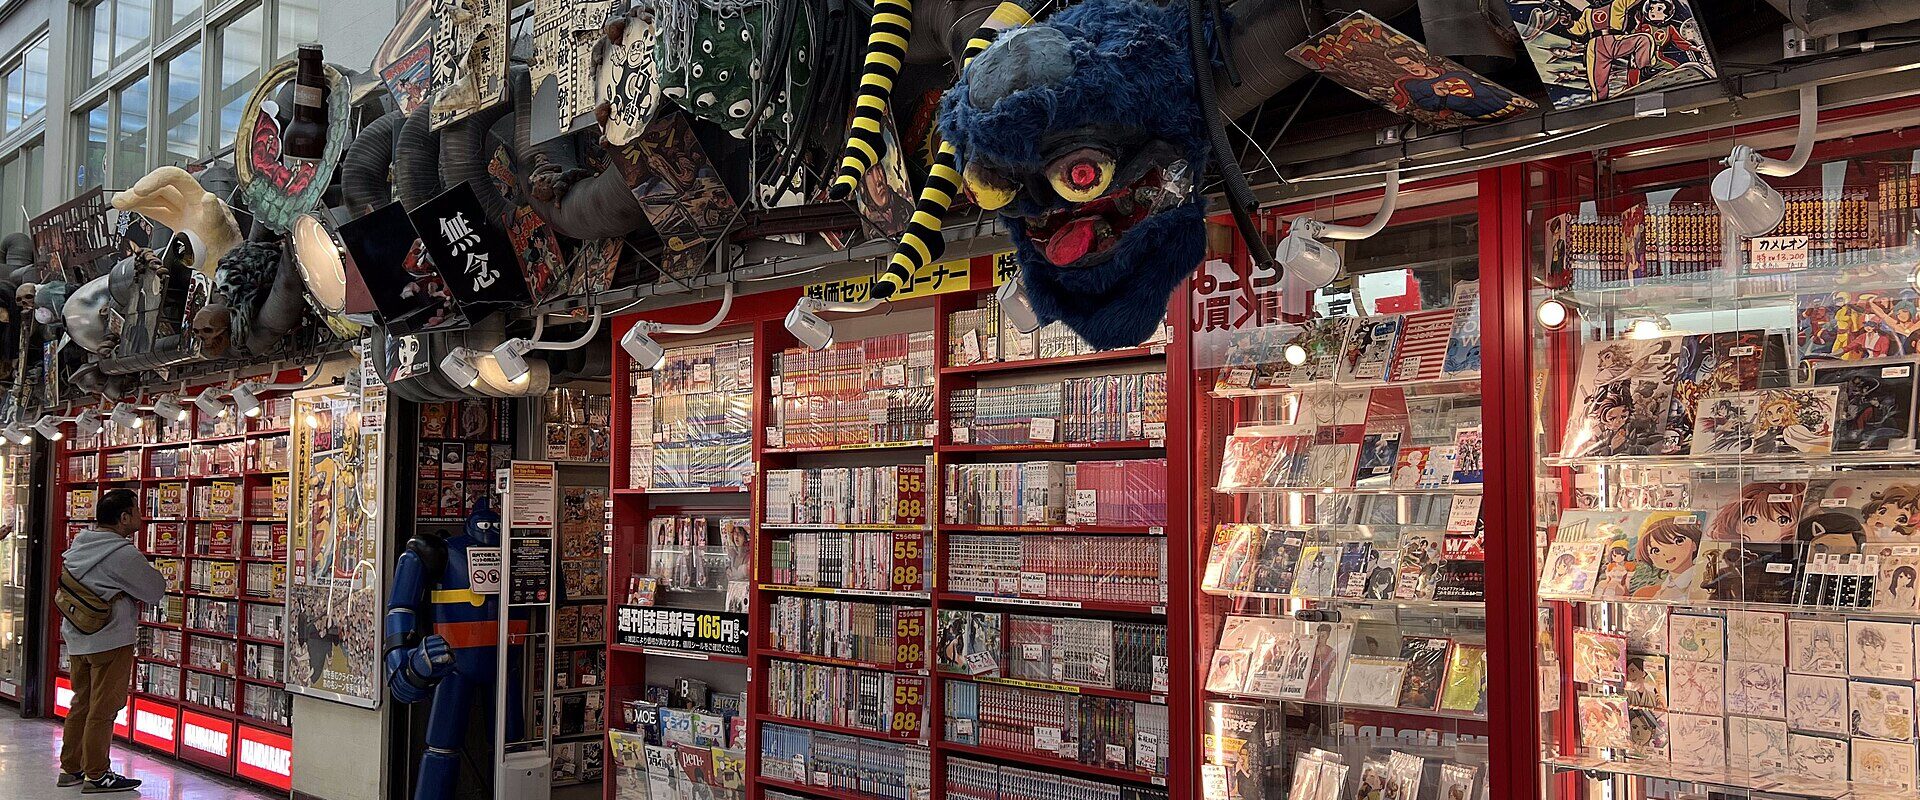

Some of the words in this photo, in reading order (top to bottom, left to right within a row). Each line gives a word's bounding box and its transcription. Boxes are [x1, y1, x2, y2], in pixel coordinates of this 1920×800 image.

[439, 211, 500, 292] 無念
[1760, 238, 1807, 250] カメレオン
[899, 475, 920, 492] 55
[216, 489, 230, 498] 110
[898, 500, 920, 517] 88
[894, 541, 917, 559] 55
[215, 570, 230, 578] 110
[893, 566, 917, 584] 88
[897, 619, 919, 637] 55
[897, 644, 919, 663] 88
[895, 687, 918, 705] 55
[634, 709, 657, 724] MOE
[893, 712, 916, 731] 88
[183, 722, 229, 757] MANDARAKE
[240, 738, 292, 776] MANDARAKE
[682, 751, 705, 768] pen+
